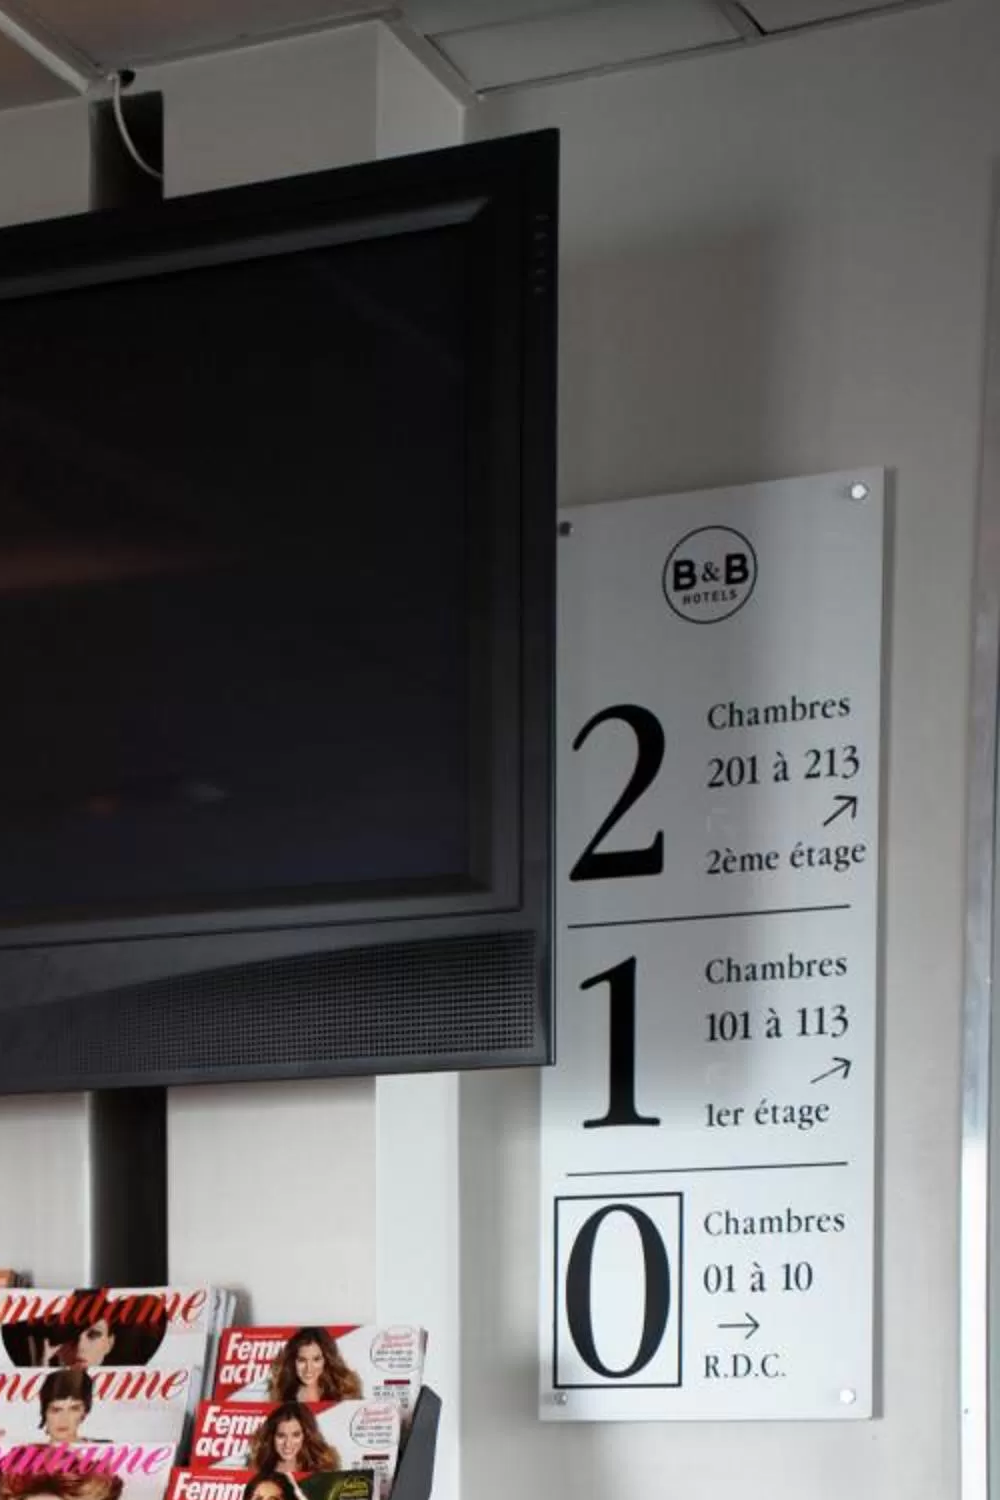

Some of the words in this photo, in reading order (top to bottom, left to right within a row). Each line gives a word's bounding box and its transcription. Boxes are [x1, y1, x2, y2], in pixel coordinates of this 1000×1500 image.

[672, 552, 749, 592] B&B
[682, 589, 738, 606] HOTELS
[707, 696, 851, 730] Chambres
[707, 756, 759, 788] 201
[773, 751, 790, 782] à
[804, 745, 860, 780] 213
[569, 704, 665, 881] 2
[706, 846, 780, 875] 2ème
[789, 841, 867, 872] étage
[705, 954, 848, 985] Chambres
[706, 1010, 752, 1042] 101
[765, 1008, 782, 1039] à
[796, 1005, 849, 1038] 113
[578, 956, 660, 1129] 1
[705, 1103, 744, 1128] 1er
[754, 1098, 830, 1130] étage
[703, 1207, 846, 1236] Chambres
[565, 1203, 671, 1379] 0
[703, 1263, 735, 1294] 01
[750, 1262, 766, 1292] à
[781, 1262, 813, 1292] 10
[225, 1332, 288, 1361] Fem
[703, 1353, 787, 1379] R.D.C.
[202, 1405, 268, 1434] Fem
